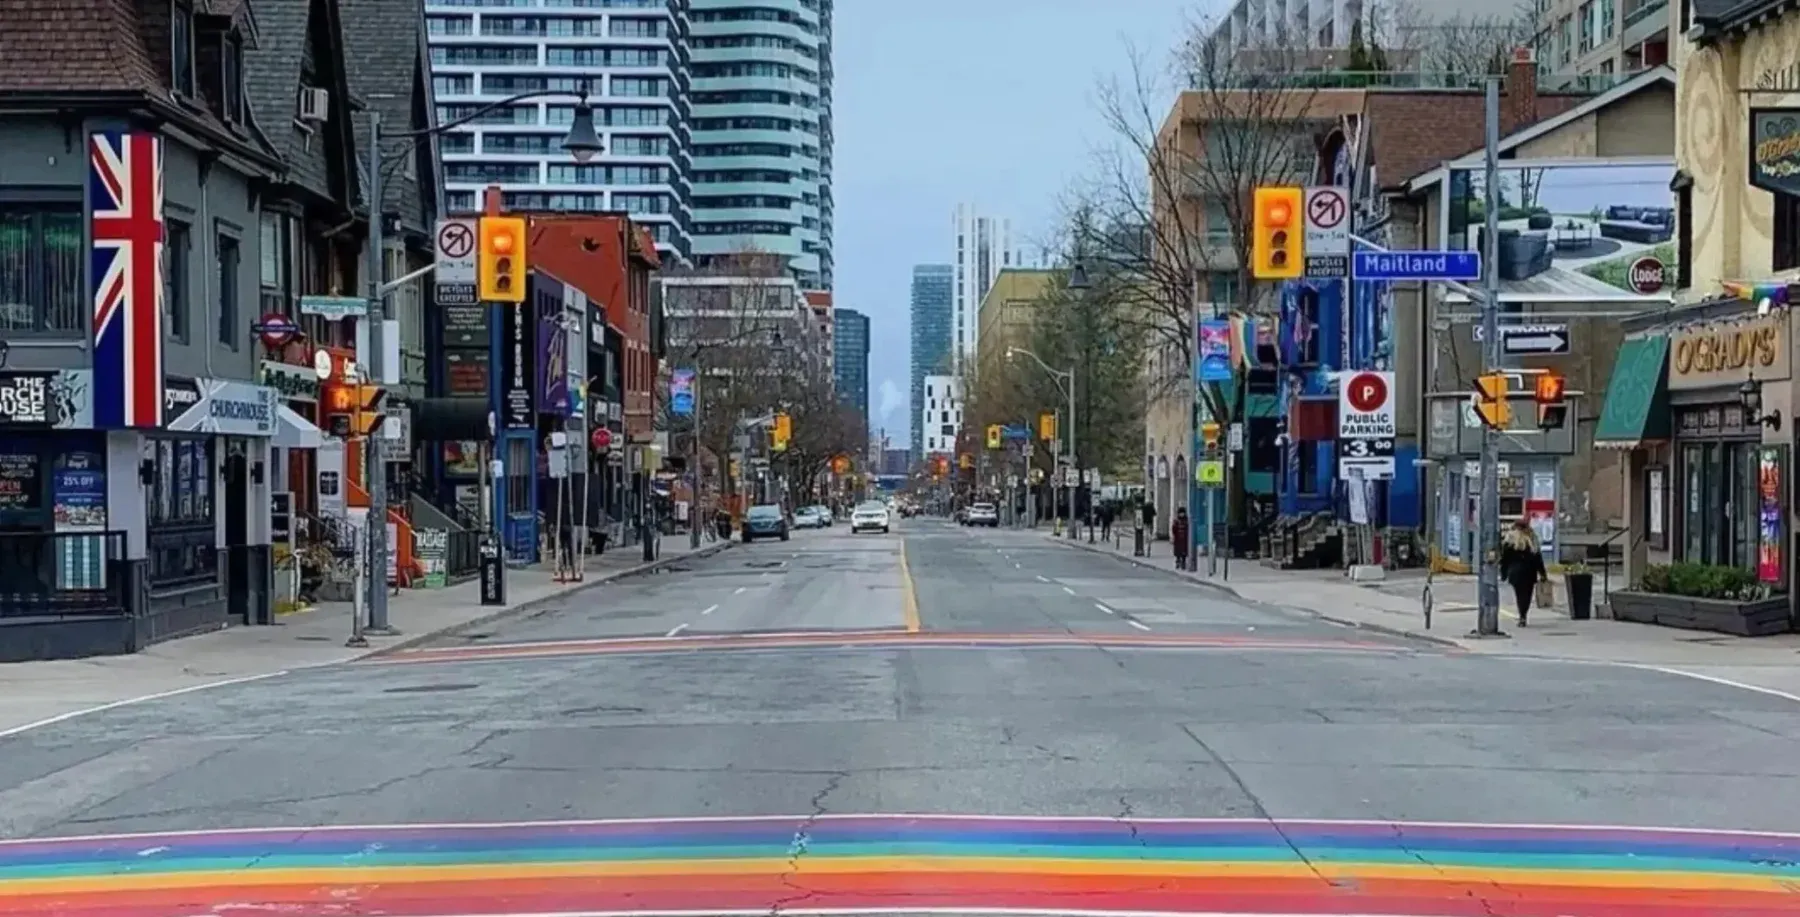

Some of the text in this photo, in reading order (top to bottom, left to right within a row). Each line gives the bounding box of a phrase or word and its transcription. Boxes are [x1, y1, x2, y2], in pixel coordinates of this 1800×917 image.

[1365, 256, 1446, 272] Maitland
[1634, 268, 1662, 281] LODGE
[13, 377, 45, 387] THE
[0, 401, 45, 415] USE
[1346, 414, 1389, 423] PUBLIC
[1341, 424, 1393, 435] PARKING
